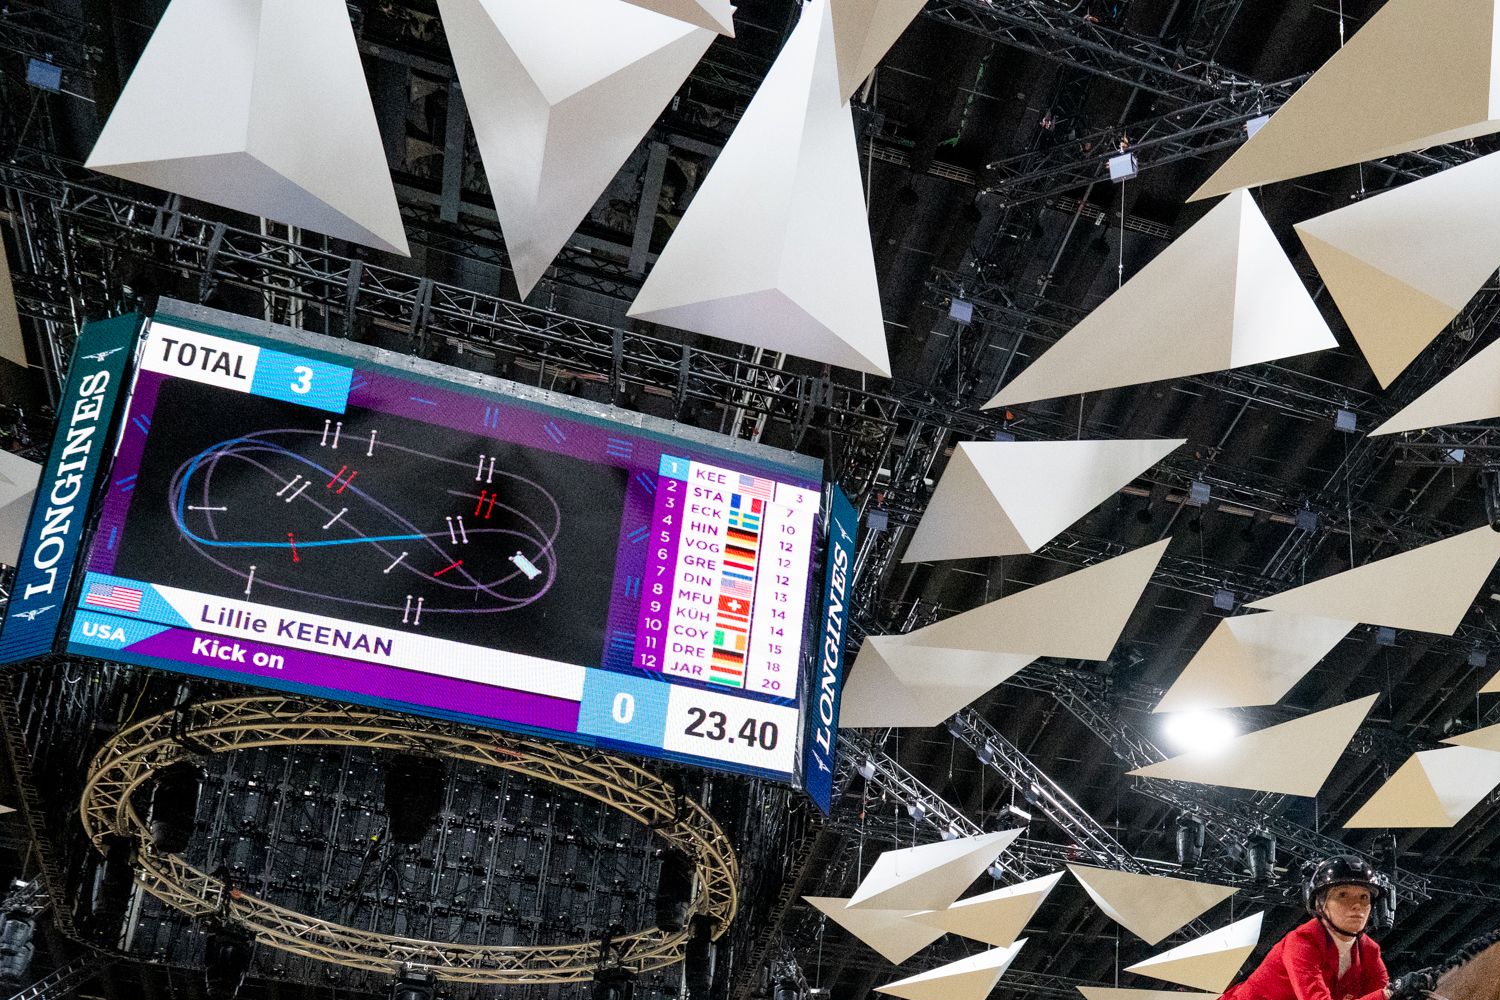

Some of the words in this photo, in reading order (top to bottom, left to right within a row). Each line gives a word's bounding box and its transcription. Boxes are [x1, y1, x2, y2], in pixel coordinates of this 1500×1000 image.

[162, 337, 246, 380] TOTAL
[290, 365, 314, 394] 3
[24, 369, 111, 601] LONGINES
[667, 481, 677, 492] 2
[694, 488, 724, 503] STA
[787, 509, 794, 518] 7
[671, 462, 677, 473] 1
[696, 469, 727, 484] KEE
[796, 495, 803, 503] 3
[662, 515, 672, 525] 4
[691, 521, 719, 535] HIN
[779, 541, 793, 552] 12
[665, 498, 675, 508] 3
[691, 504, 722, 518] ECK
[781, 526, 795, 535] 10
[658, 549, 667, 559] 6
[684, 555, 716, 570] GRE
[776, 575, 789, 586] 12
[660, 532, 670, 542] 5
[685, 537, 720, 553] VOG
[778, 558, 791, 569] 12
[652, 584, 663, 595] 8
[678, 589, 712, 604] MFU
[772, 609, 786, 620] 14
[657, 566, 666, 576] 7
[684, 573, 712, 587] DIN
[775, 591, 787, 602] 13
[82, 621, 126, 643] USA
[200, 604, 268, 633] Lillie
[277, 618, 393, 657] KEENAN
[645, 618, 662, 630] 10
[674, 625, 709, 639] COY
[769, 643, 782, 654] 15
[650, 601, 661, 612] 9
[676, 606, 710, 622] KÜH
[770, 626, 784, 637] 14
[191, 637, 247, 663] Kick
[252, 650, 285, 670] on
[646, 637, 657, 648] 11
[672, 643, 705, 657] DRE
[767, 661, 780, 672] 18
[816, 542, 849, 755] LONGINES
[641, 654, 656, 667] 12
[670, 661, 703, 675] JAR
[762, 679, 780, 690] 20
[612, 692, 635, 724] 0
[684, 707, 779, 751] 23.40
